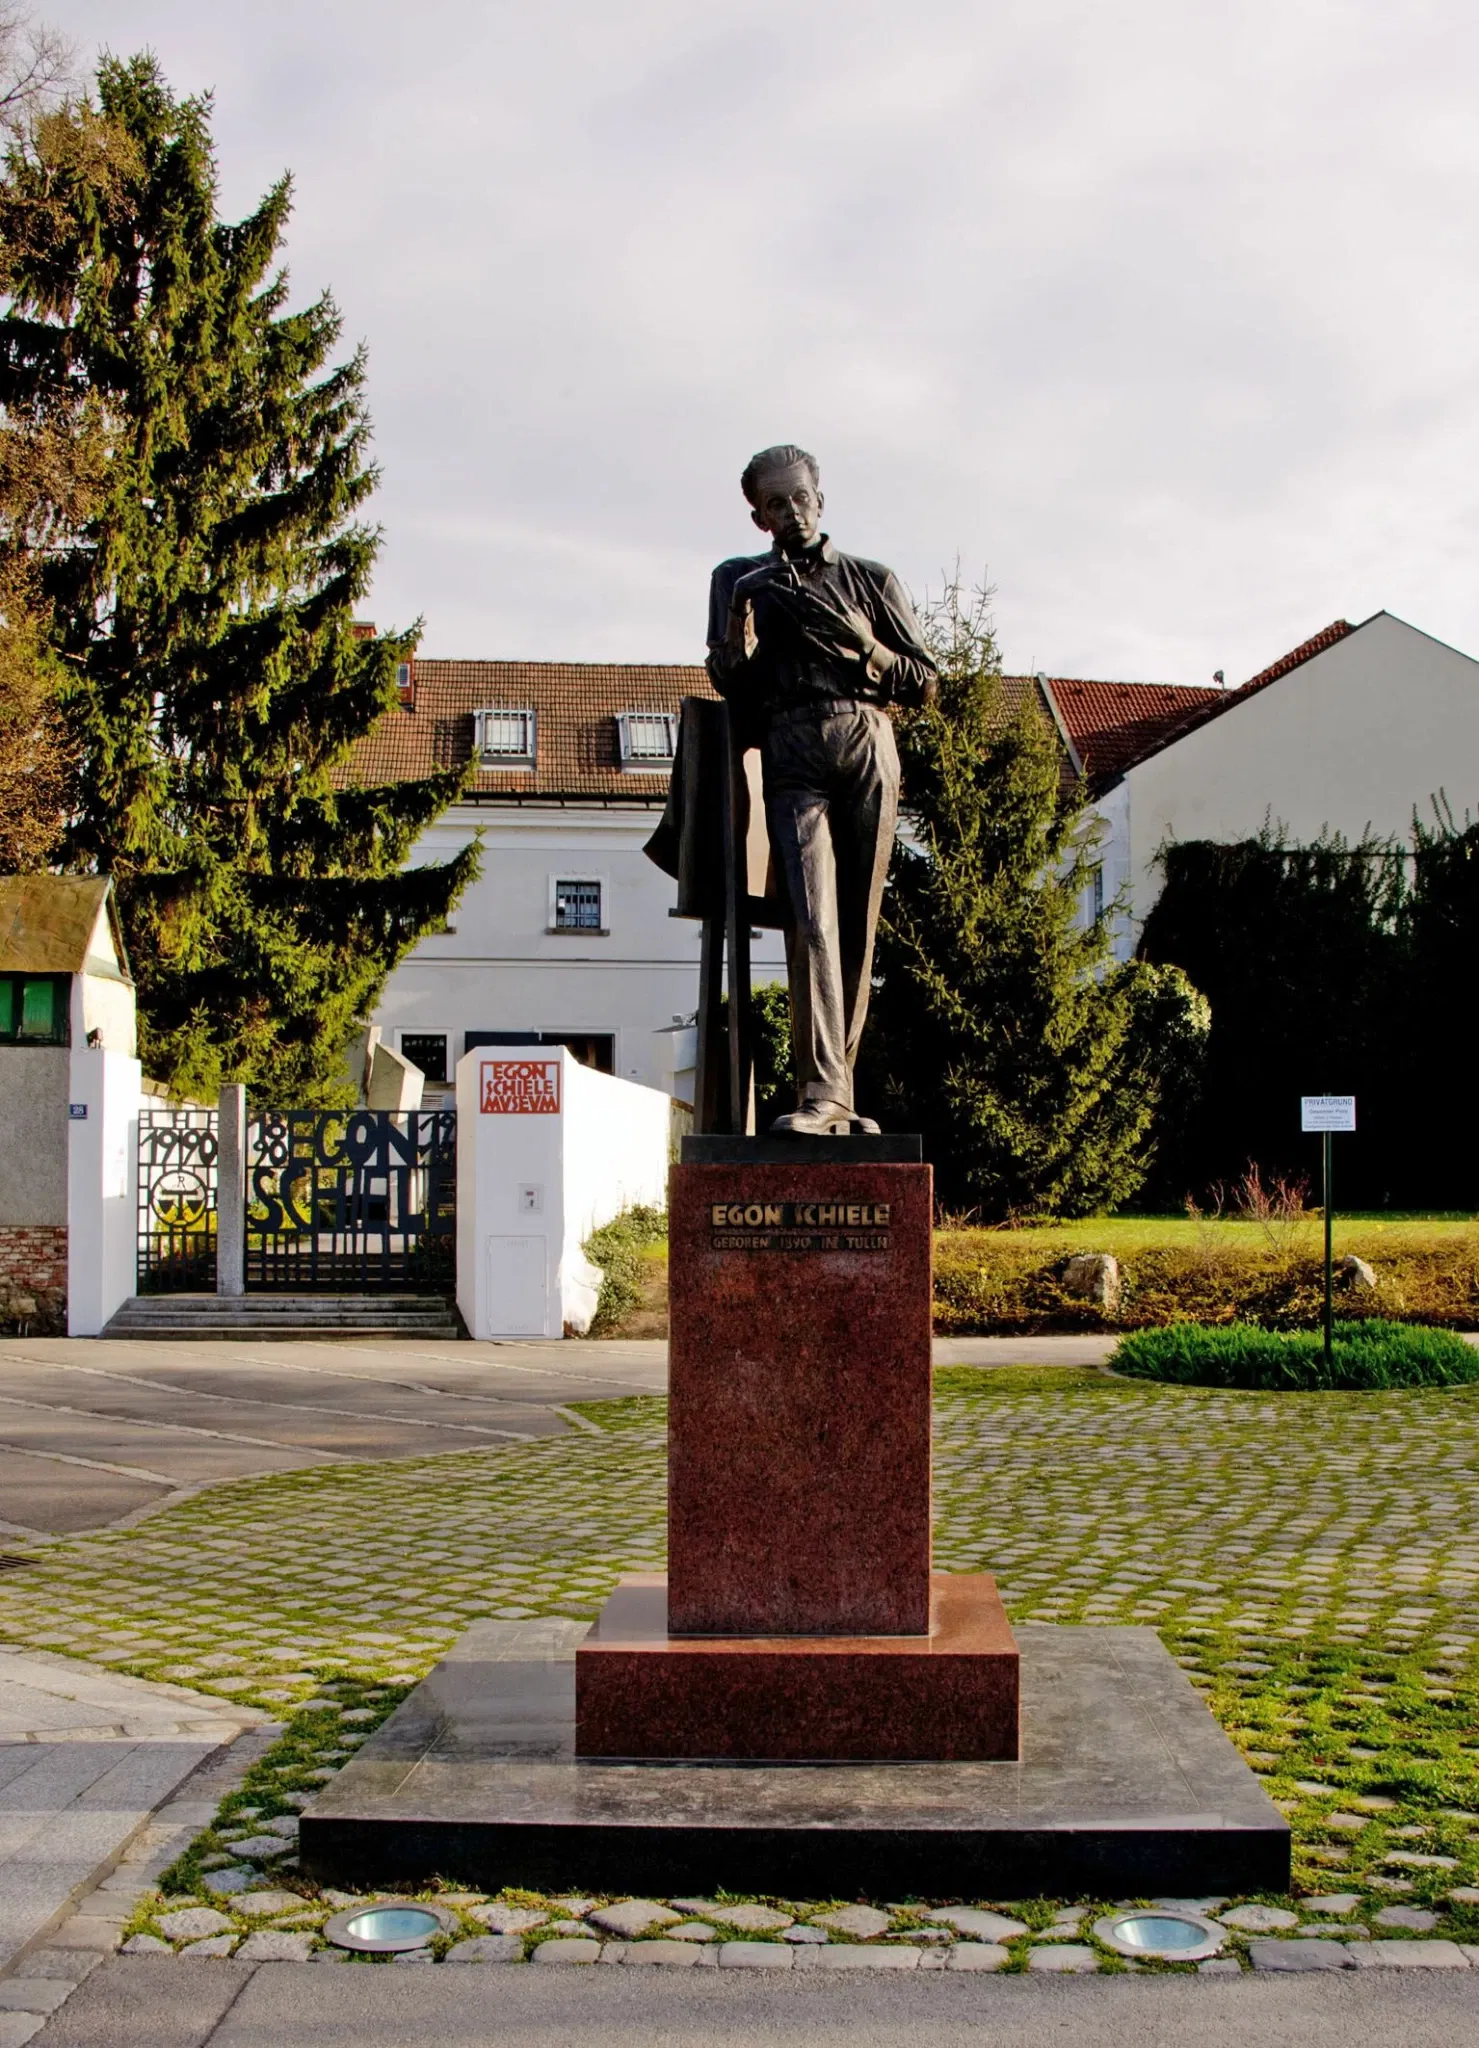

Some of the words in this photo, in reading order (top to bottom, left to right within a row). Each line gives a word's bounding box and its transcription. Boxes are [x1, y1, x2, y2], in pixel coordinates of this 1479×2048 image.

[493, 1064, 547, 1080] EGON
[486, 1080, 554, 1096] SCHIELE
[1304, 1098, 1352, 1106] PRIVATGRUND
[72, 1106, 84, 1115] 28
[139, 1127, 218, 1167] 1990
[288, 1111, 418, 1167] EGON
[247, 1166, 456, 1234] SCHIELE
[712, 1204, 784, 1226] EGON
[713, 1236, 770, 1249] GEBOREN
[847, 1236, 889, 1249] TULLN
